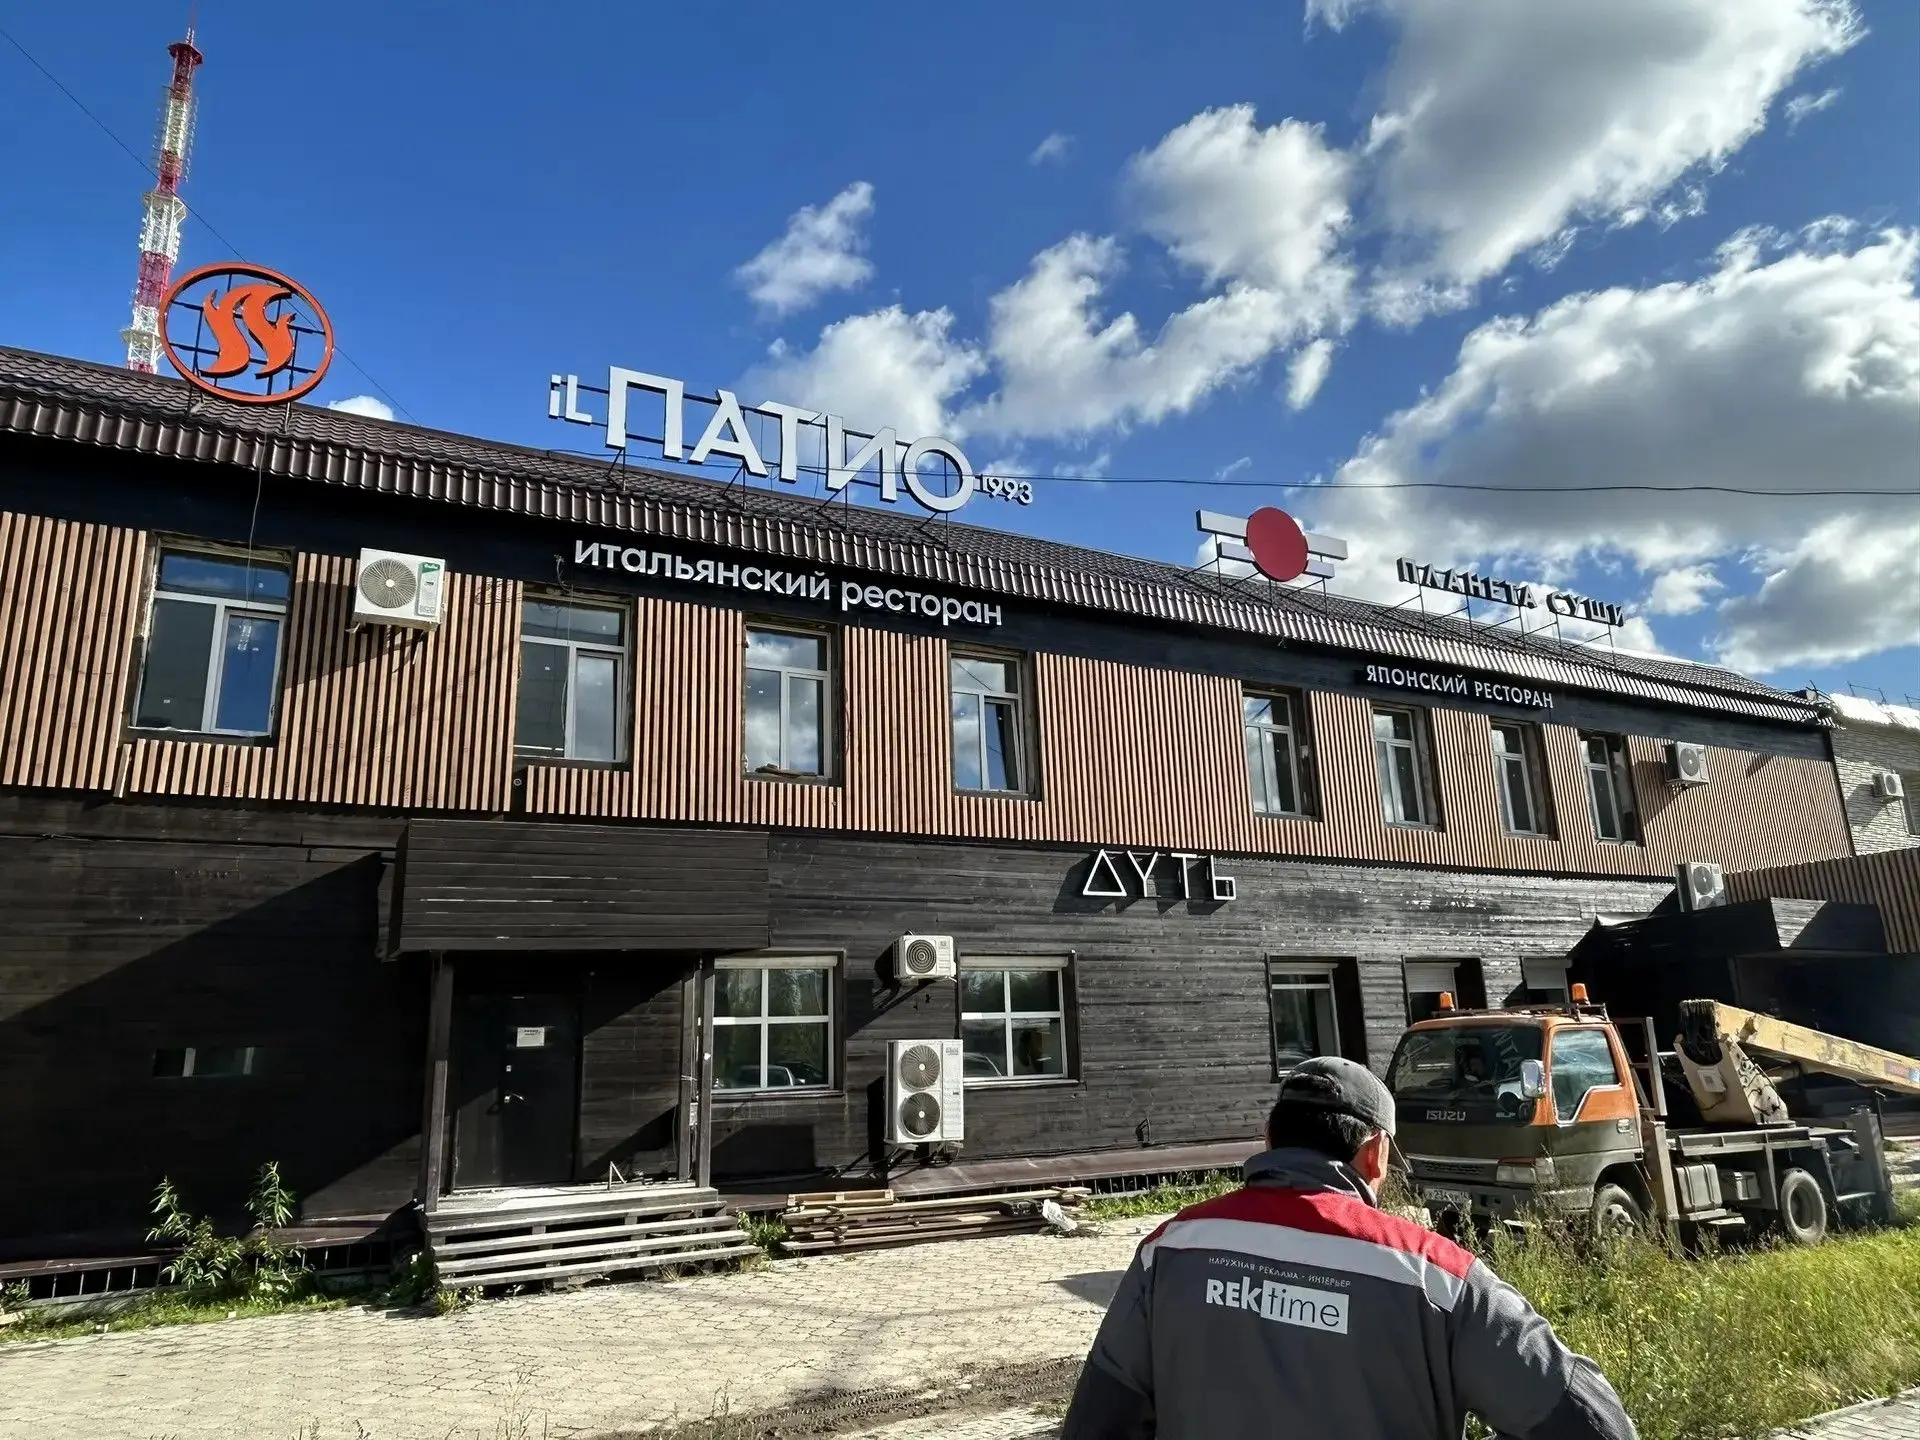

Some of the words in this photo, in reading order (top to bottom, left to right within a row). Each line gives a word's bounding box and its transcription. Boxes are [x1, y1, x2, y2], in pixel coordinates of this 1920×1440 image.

[606, 365, 974, 513] ПАТИО
[980, 475, 1033, 504] 1993
[574, 540, 831, 601] итальянский
[841, 578, 1002, 627] ресторан
[1396, 557, 1538, 609] ПЛАНЕТА
[1546, 591, 1625, 627] СУШИ
[1366, 664, 1468, 695] ЯПОНСКИЙ
[1474, 681, 1554, 709] РЕСТОРАН
[1426, 1110, 1466, 1121] ISUZU
[1208, 1257, 1256, 1271] НАРУЖНАЯ
[1259, 1265, 1299, 1280] РЕКЛАМА
